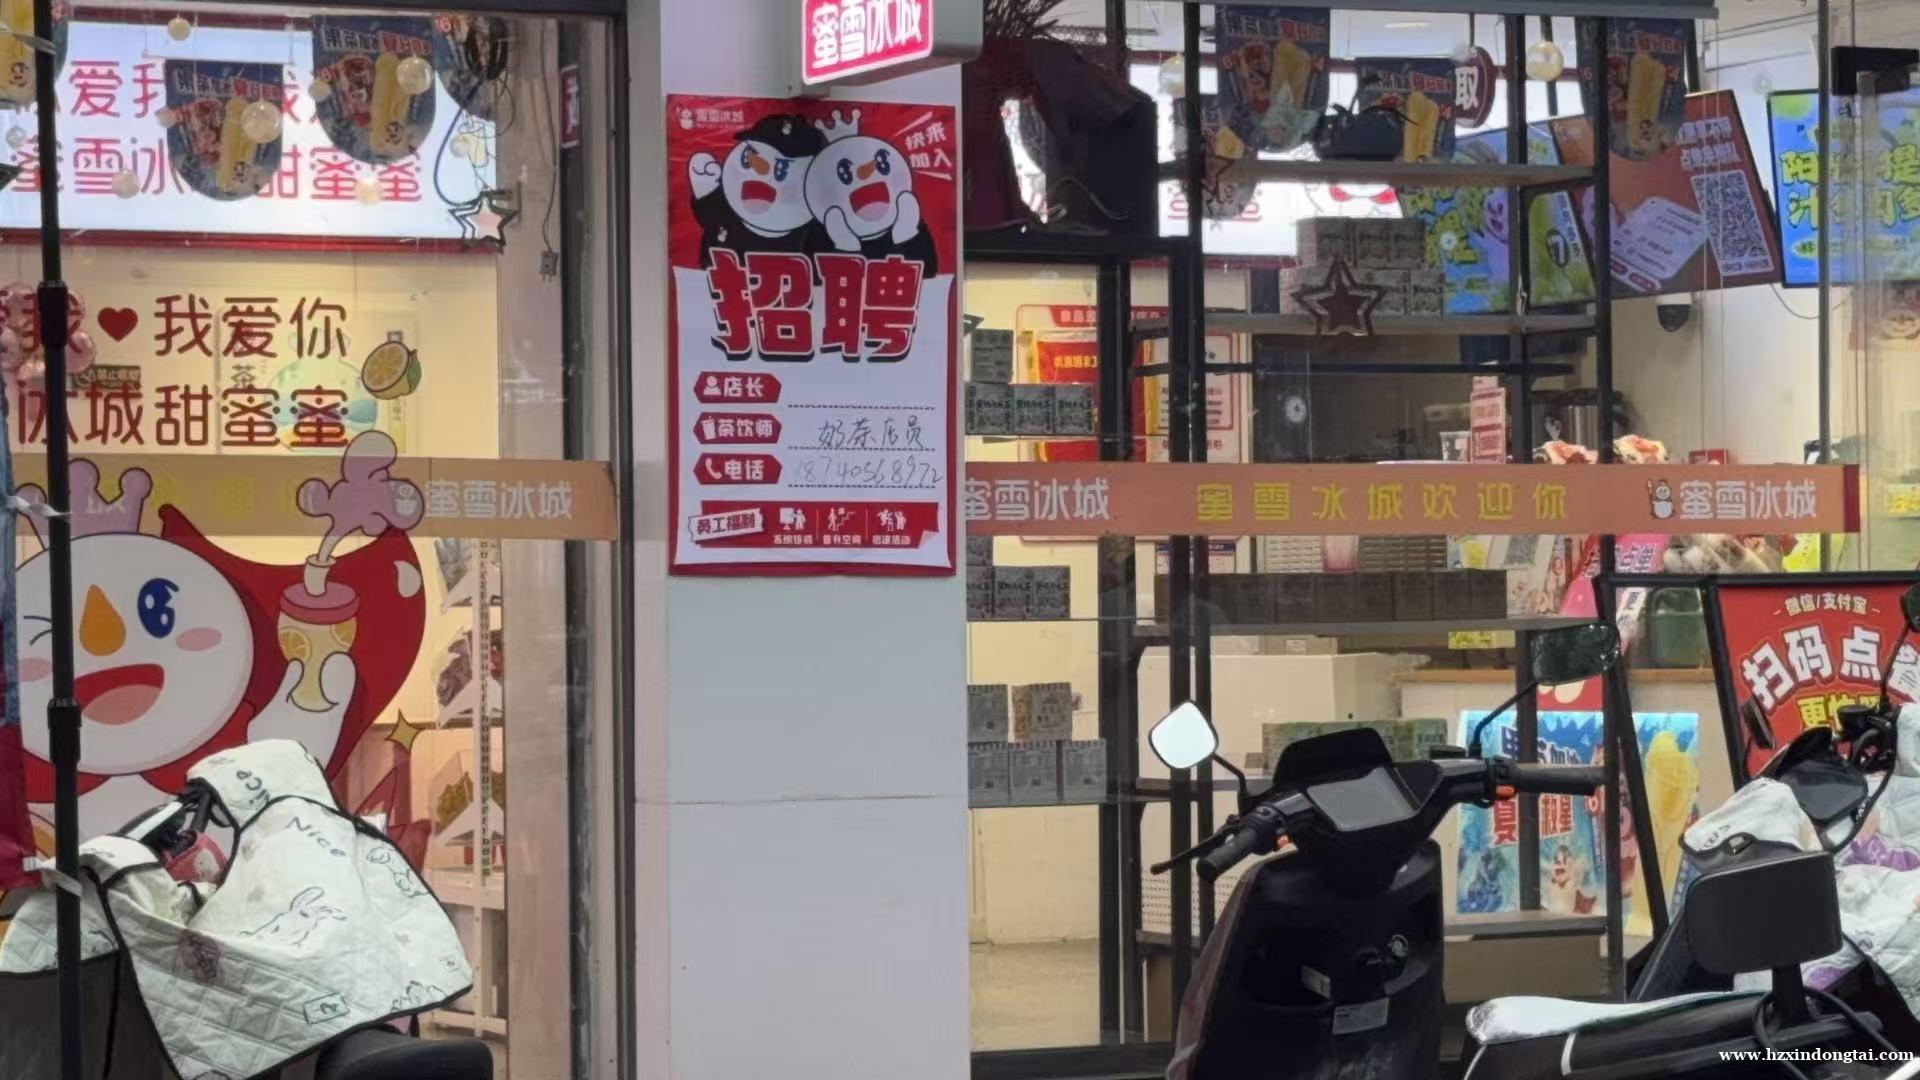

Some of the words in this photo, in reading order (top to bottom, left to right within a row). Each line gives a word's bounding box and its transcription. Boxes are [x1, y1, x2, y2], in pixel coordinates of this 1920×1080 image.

[812, 0, 923, 69] 蜜雪冰城
[905, 121, 946, 151] 快来
[910, 149, 953, 169] 加入
[706, 247, 926, 362] 招聘
[154, 293, 348, 359] 我爱你
[723, 375, 765, 398] 店长
[718, 418, 774, 438] 茶饮师
[818, 415, 925, 449] 奶茶店员
[724, 459, 765, 481] 电话
[424, 480, 573, 521] 蜜雪冰城
[964, 478, 1110, 521] 蜜雪冰城
[1679, 478, 1817, 520] 蜜雪冰城
[697, 511, 757, 535] 员工福利
[286, 815, 347, 857] Nice
